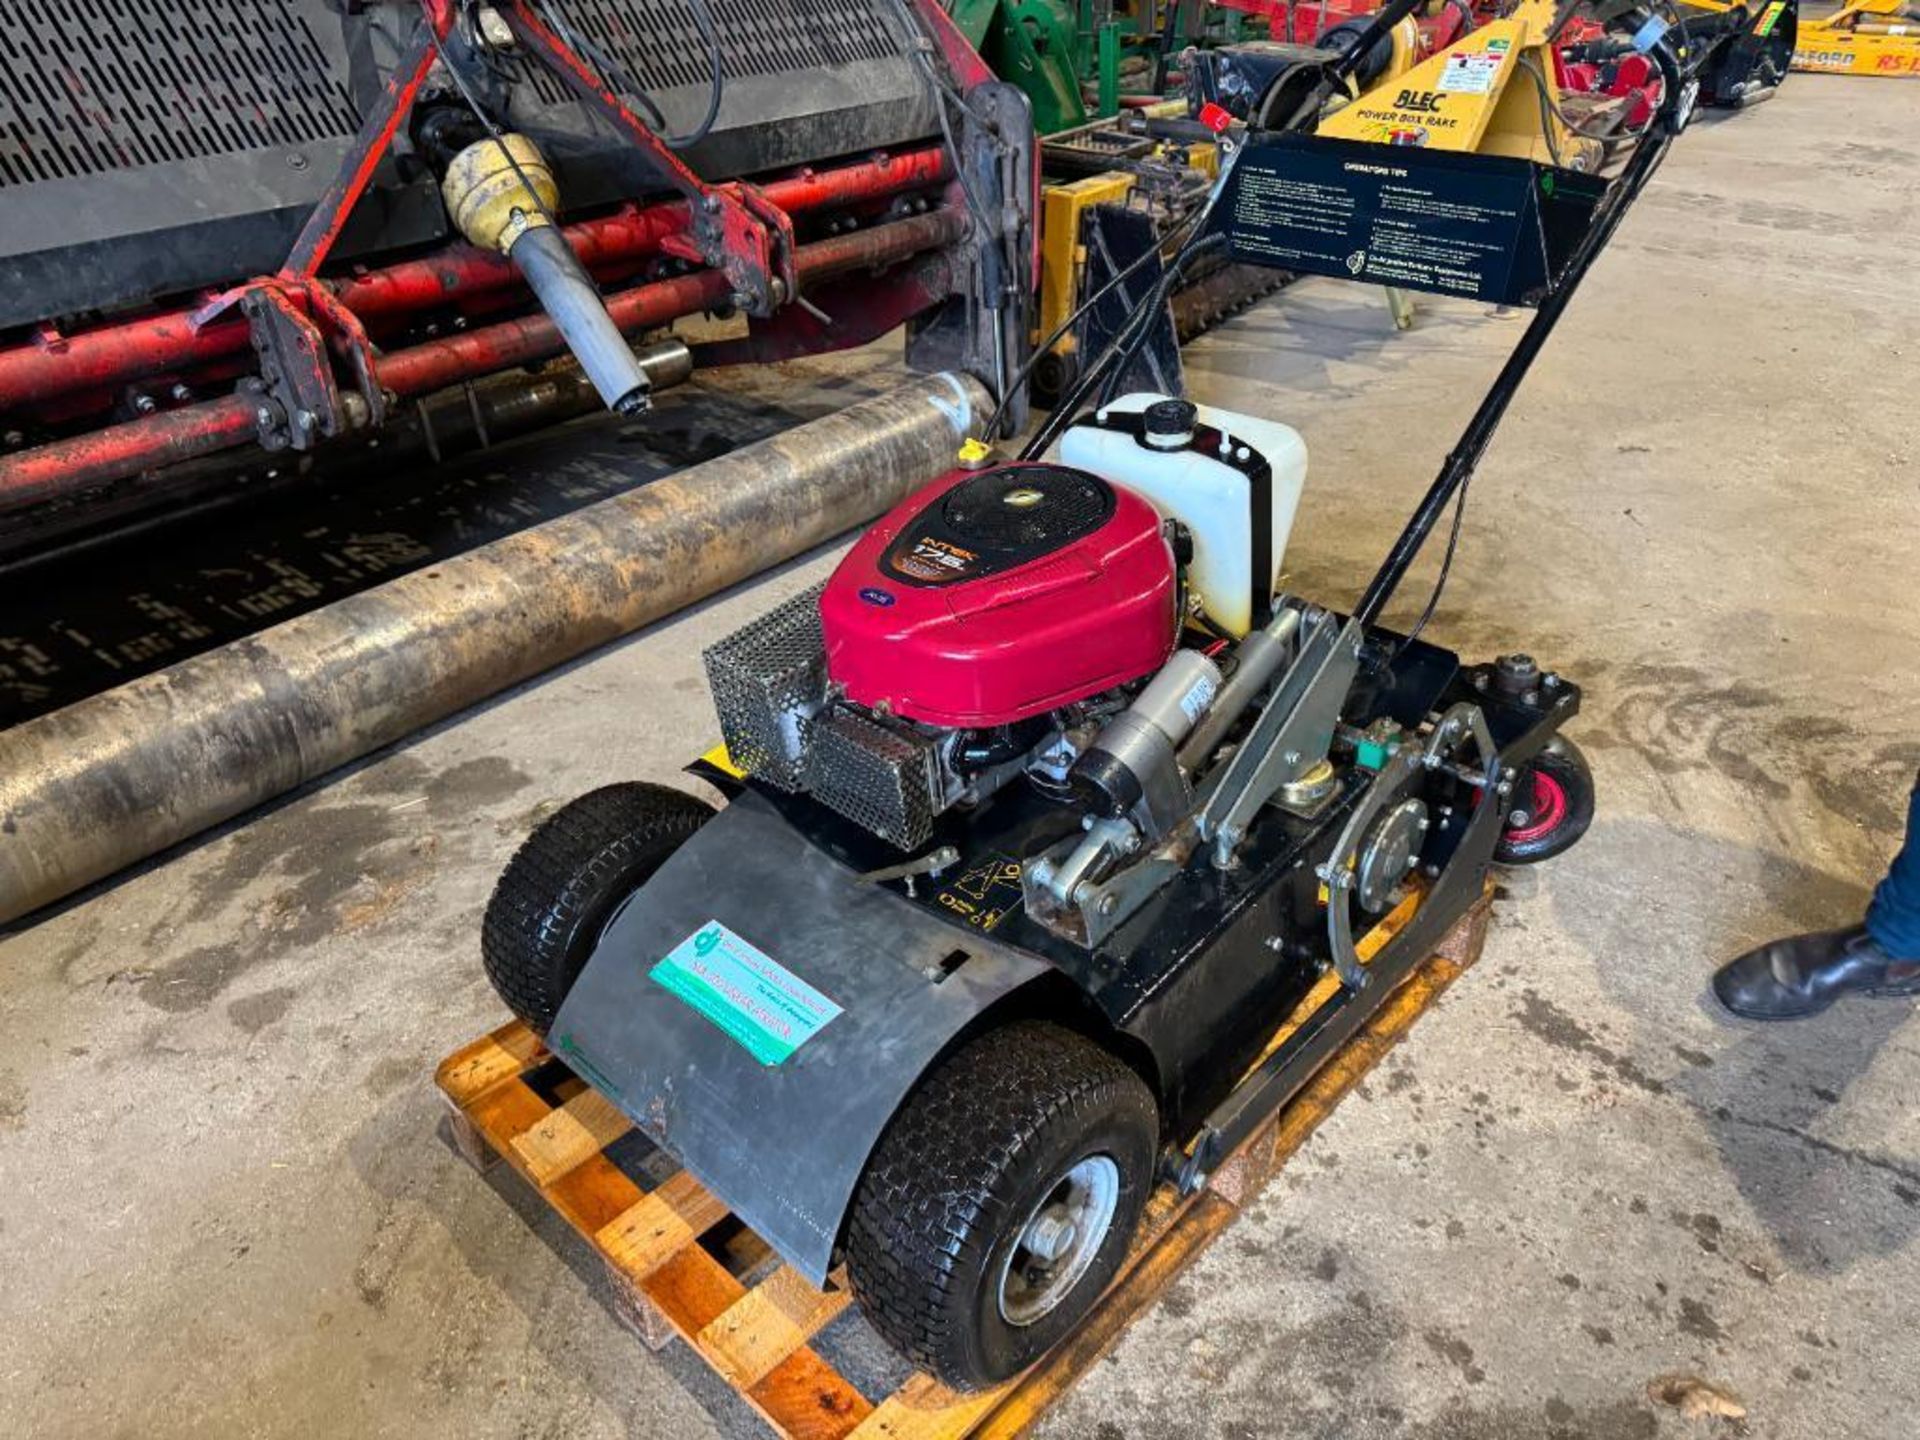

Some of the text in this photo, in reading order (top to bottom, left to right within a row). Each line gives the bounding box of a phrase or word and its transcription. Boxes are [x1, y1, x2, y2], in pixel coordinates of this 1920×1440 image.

[1393, 89, 1447, 112] BLEC
[1357, 108, 1458, 128] POWER BOX RAKE
